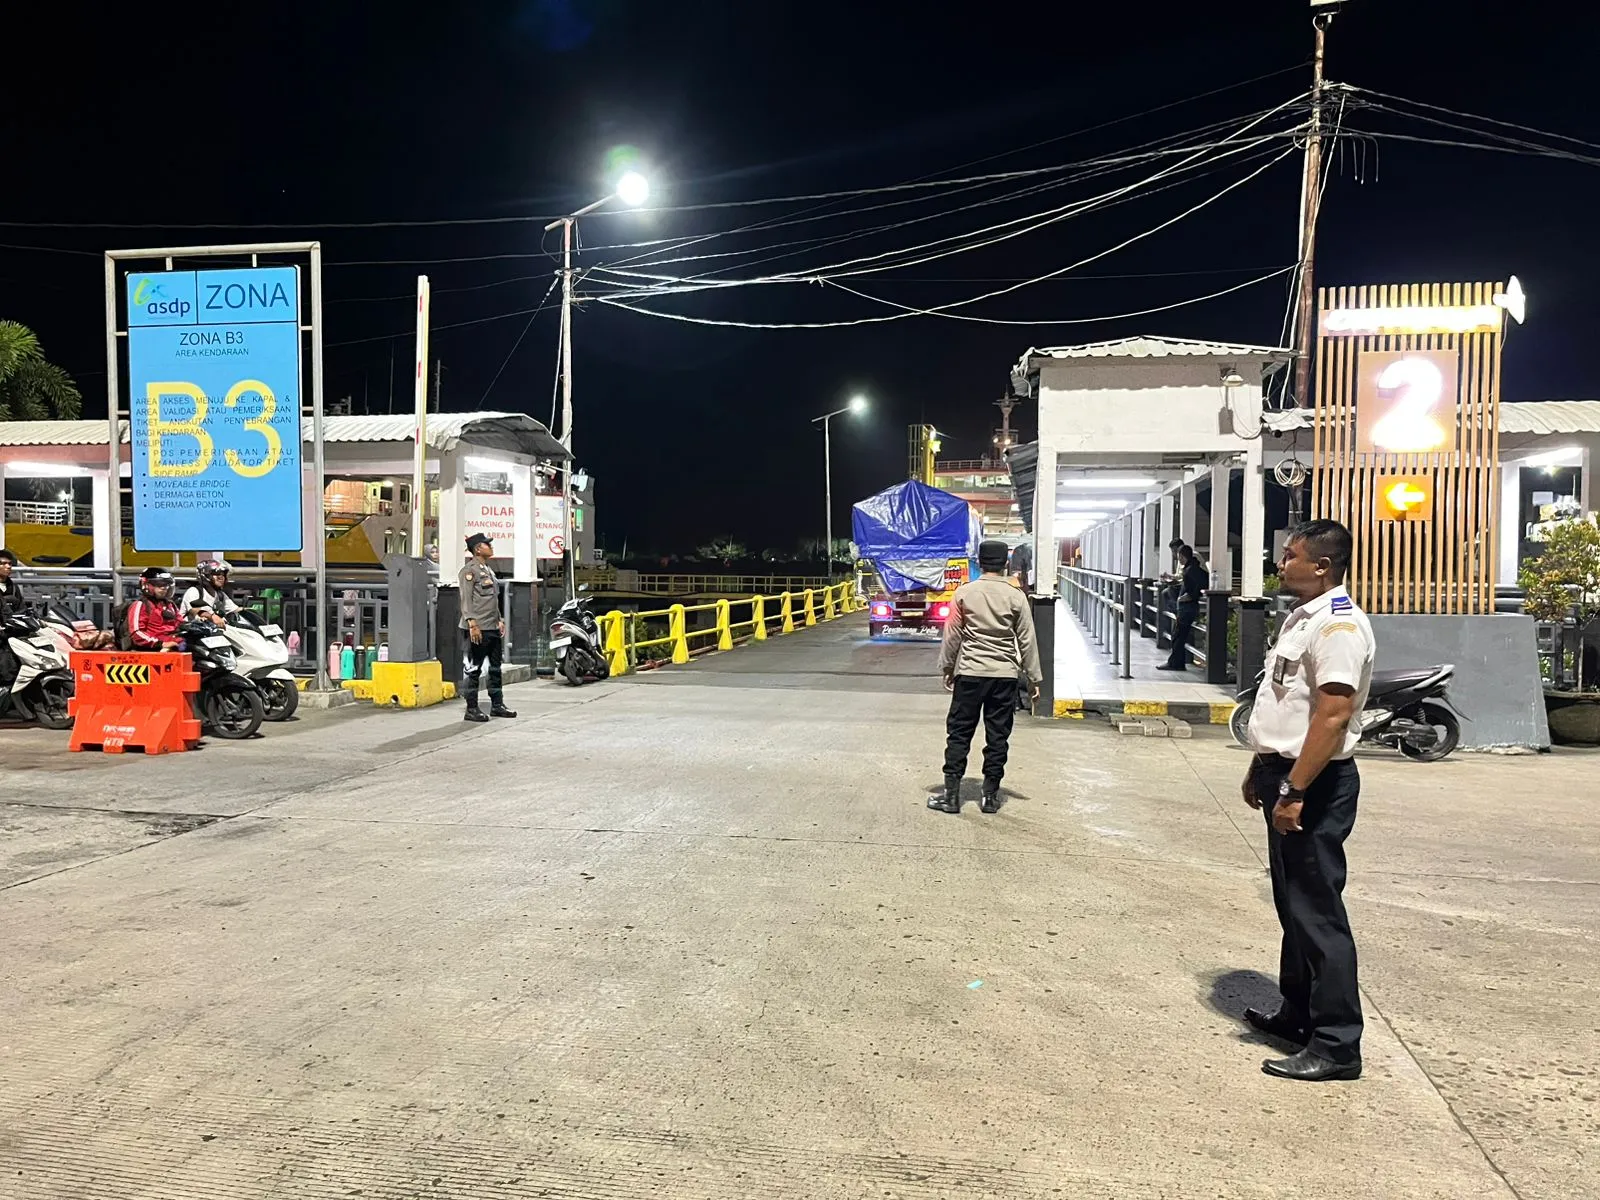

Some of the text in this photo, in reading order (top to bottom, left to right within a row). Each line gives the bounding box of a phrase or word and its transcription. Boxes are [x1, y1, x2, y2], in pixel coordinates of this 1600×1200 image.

[205, 282, 290, 310] ZONA
[147, 298, 190, 317] asdp
[179, 331, 244, 346] ZONA B3
[175, 348, 249, 358] AREA KENDARAAN
[135, 394, 290, 405] AREA AKSES MENUJU KE KAPAL &
[1371, 356, 1445, 450] 2
[135, 405, 292, 416] AREA VALIDASI ATAU PEMERIKSAAN
[136, 416, 292, 426] TIKET ANGKUTAN PENYEBRANGAN
[135, 427, 206, 437] BAGI KENDARAAN
[146, 379, 282, 478] B3
[153, 447, 292, 457] POS PEMERIKSAAN ATAU
[153, 457, 295, 467] MANLESS VALIDATOR TIKET
[154, 479, 232, 489] MOVEABLE BRIDGE
[154, 490, 224, 499] DERMAGA BETON
[154, 500, 231, 509] DERMAGA PONTON
